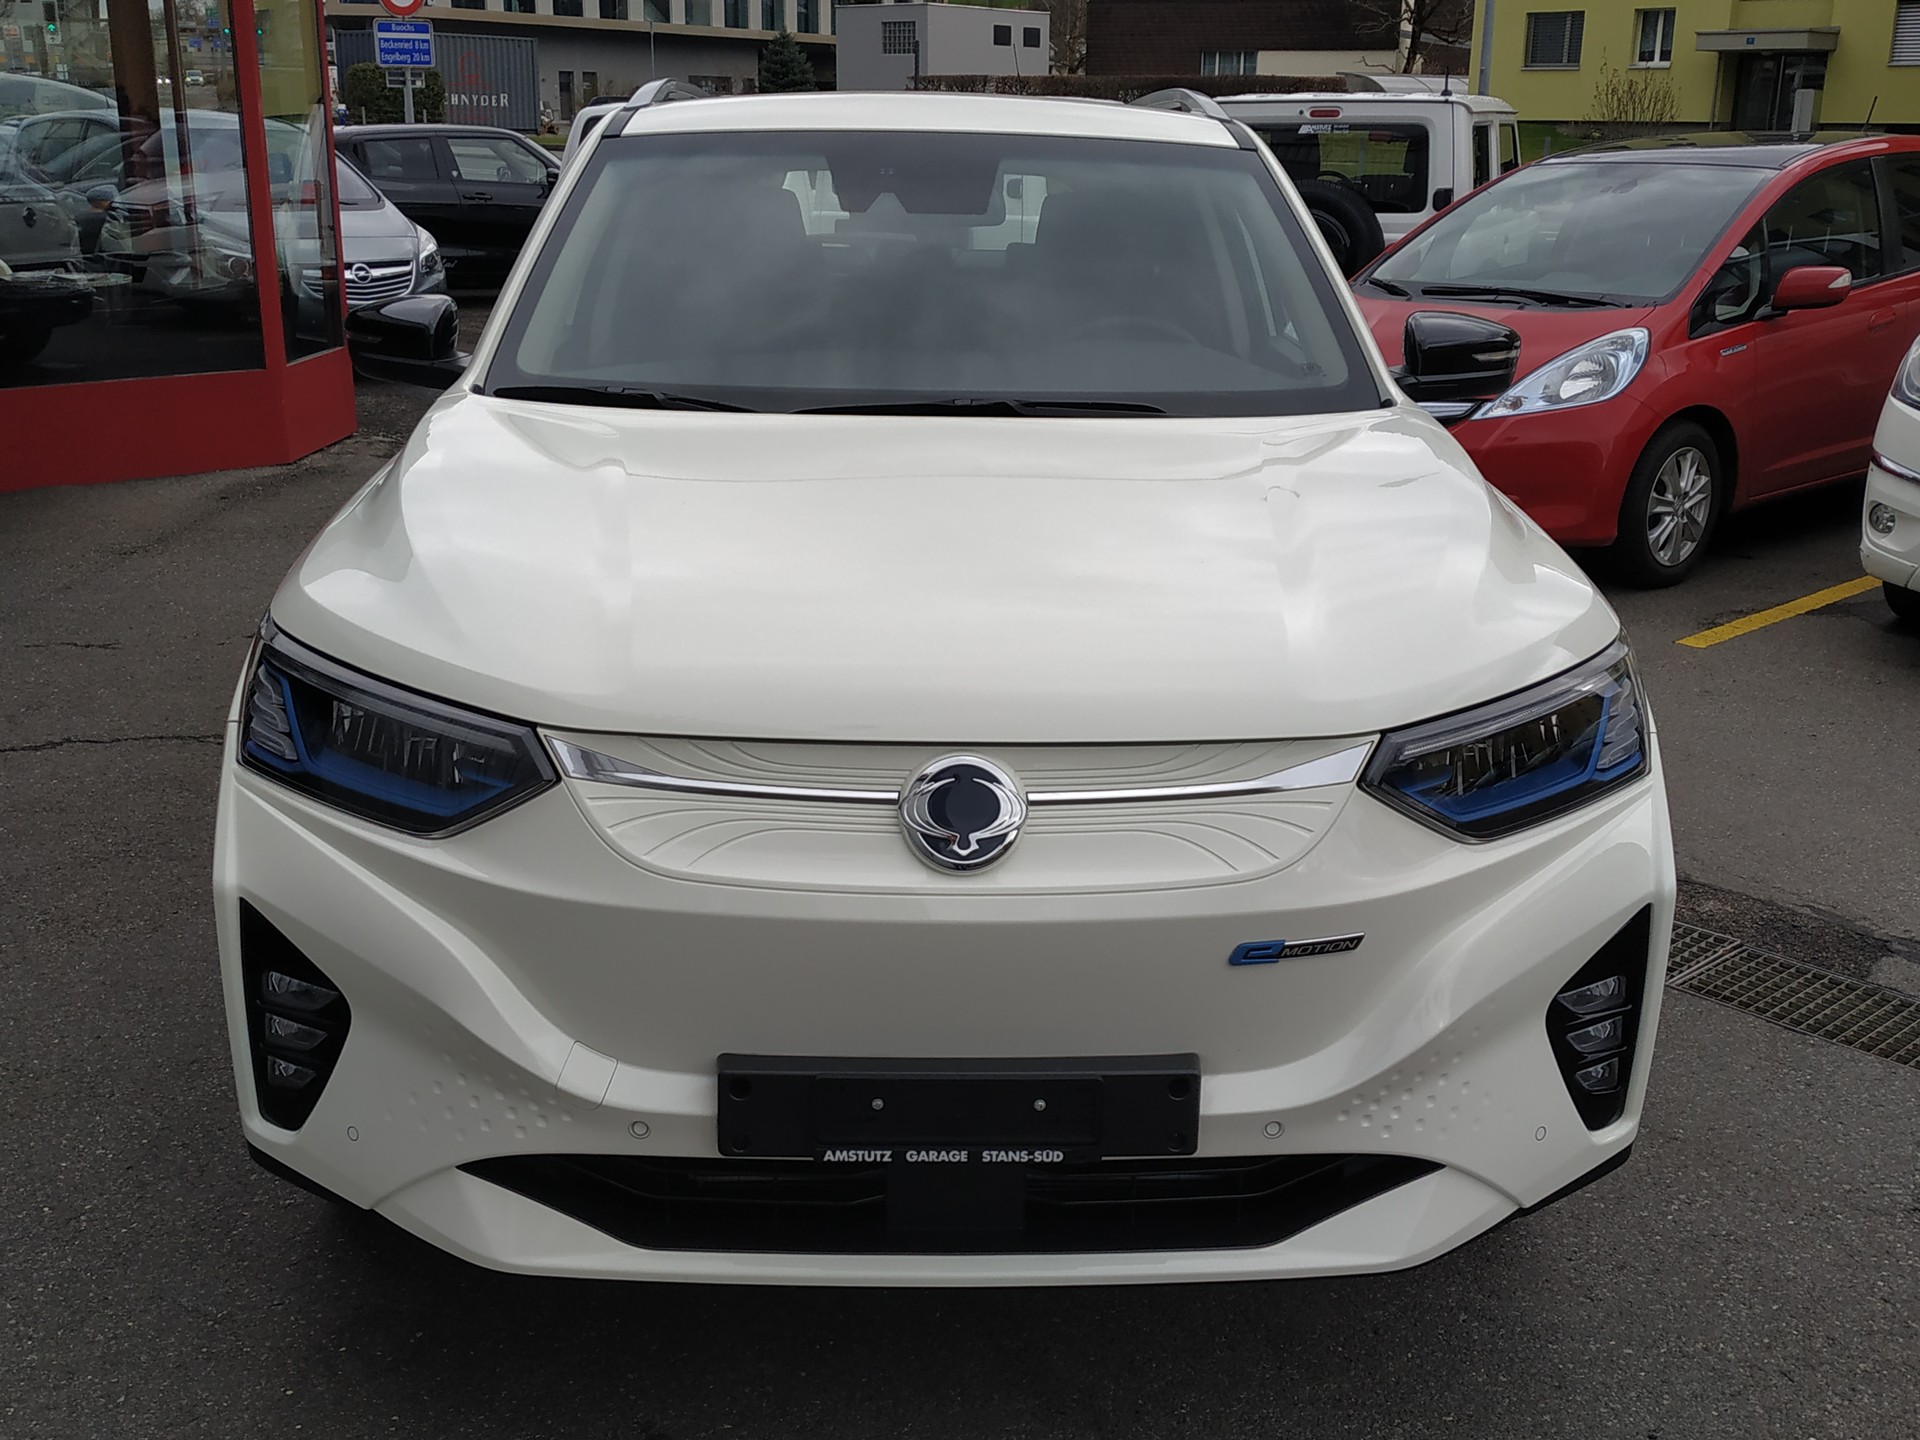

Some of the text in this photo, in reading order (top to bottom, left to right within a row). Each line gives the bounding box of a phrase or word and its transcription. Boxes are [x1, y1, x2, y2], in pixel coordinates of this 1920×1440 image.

[391, 23, 415, 31] Buochs
[380, 39, 429, 49] Beckenried 8 km
[381, 51, 430, 64] Engelberg 20 km
[823, 1149, 1064, 1163] AMSTUTZ GARAGE STANS-SÜD
